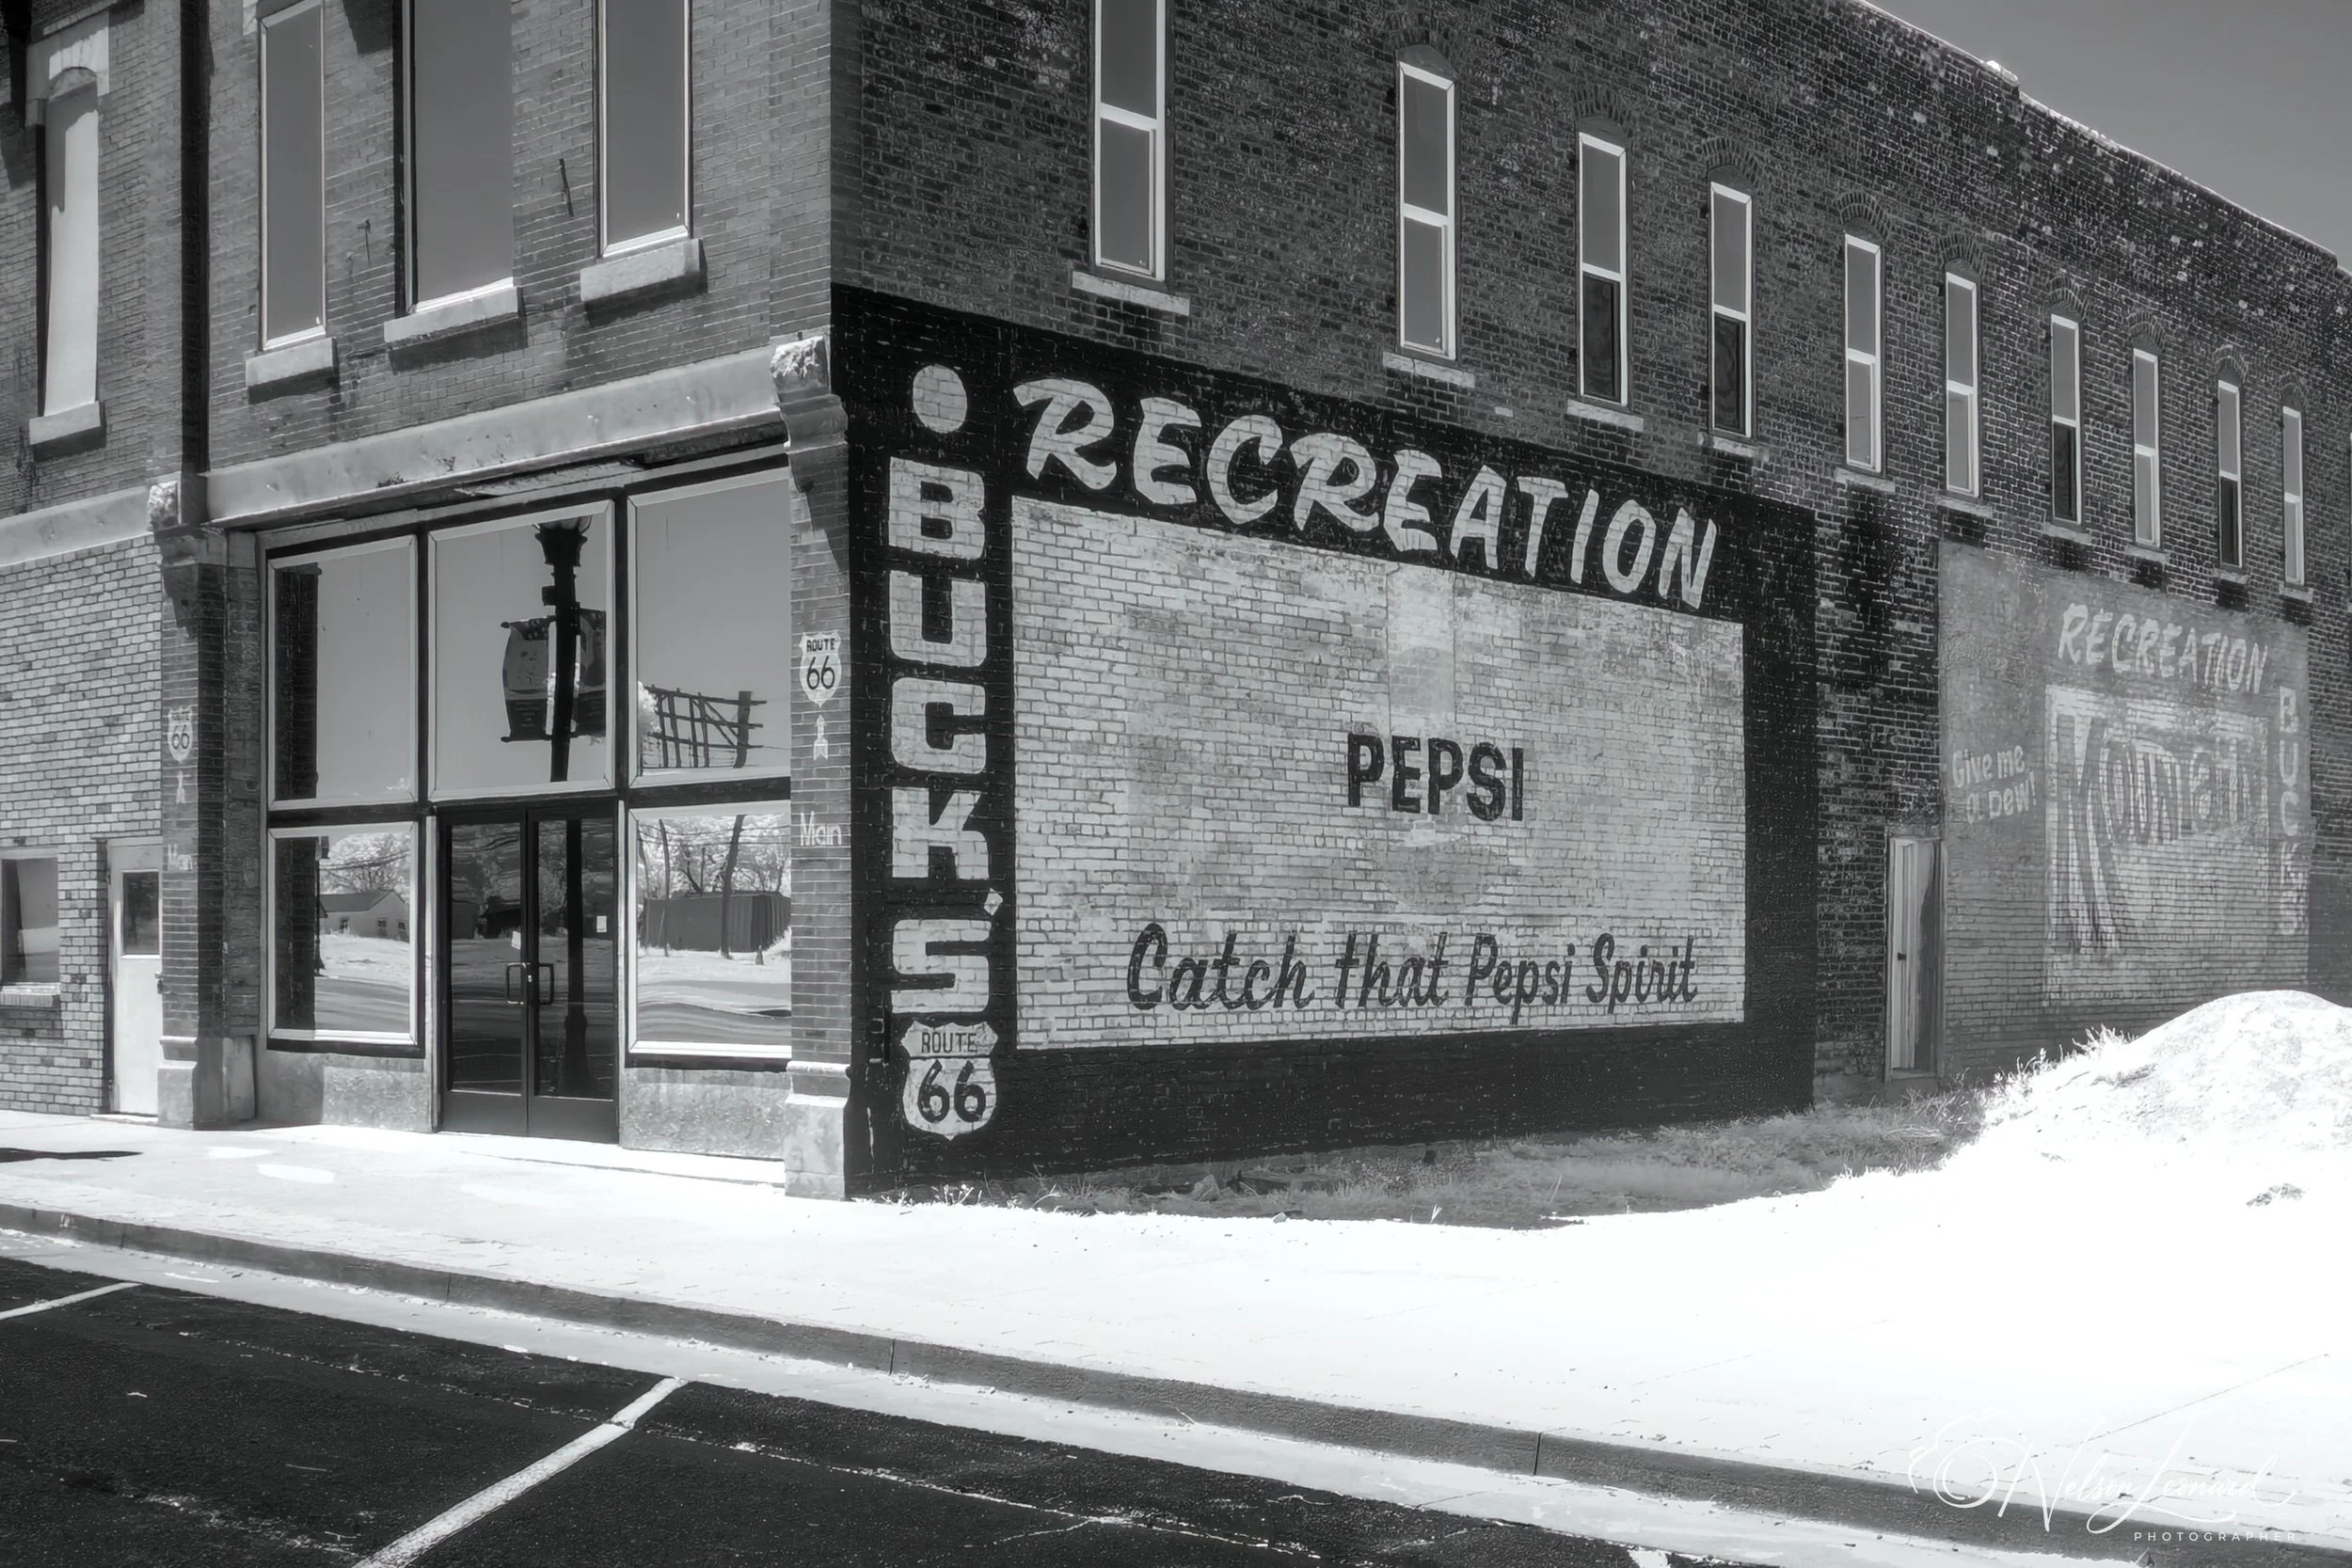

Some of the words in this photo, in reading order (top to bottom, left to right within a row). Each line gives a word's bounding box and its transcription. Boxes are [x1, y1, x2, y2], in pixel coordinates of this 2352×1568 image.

[1013, 378, 1718, 610] RECREATION
[806, 639, 835, 652] ROUTE
[2058, 605, 2267, 694] RECREATION
[806, 656, 835, 690] 66
[172, 723, 190, 750] 66
[887, 456, 1003, 1013] BUCK'S
[1347, 731, 1524, 821] PEPSI
[1952, 749, 1994, 788] Give
[1996, 745, 2026, 780] me
[801, 811, 842, 847] Main
[1129, 922, 1315, 1011] Catch
[1335, 931, 1449, 1008] that
[1464, 932, 1576, 1025] Pepsi
[1585, 932, 1698, 1014] Spirit
[921, 1032, 978, 1053] ROUTE
[917, 1060, 987, 1123] 66
